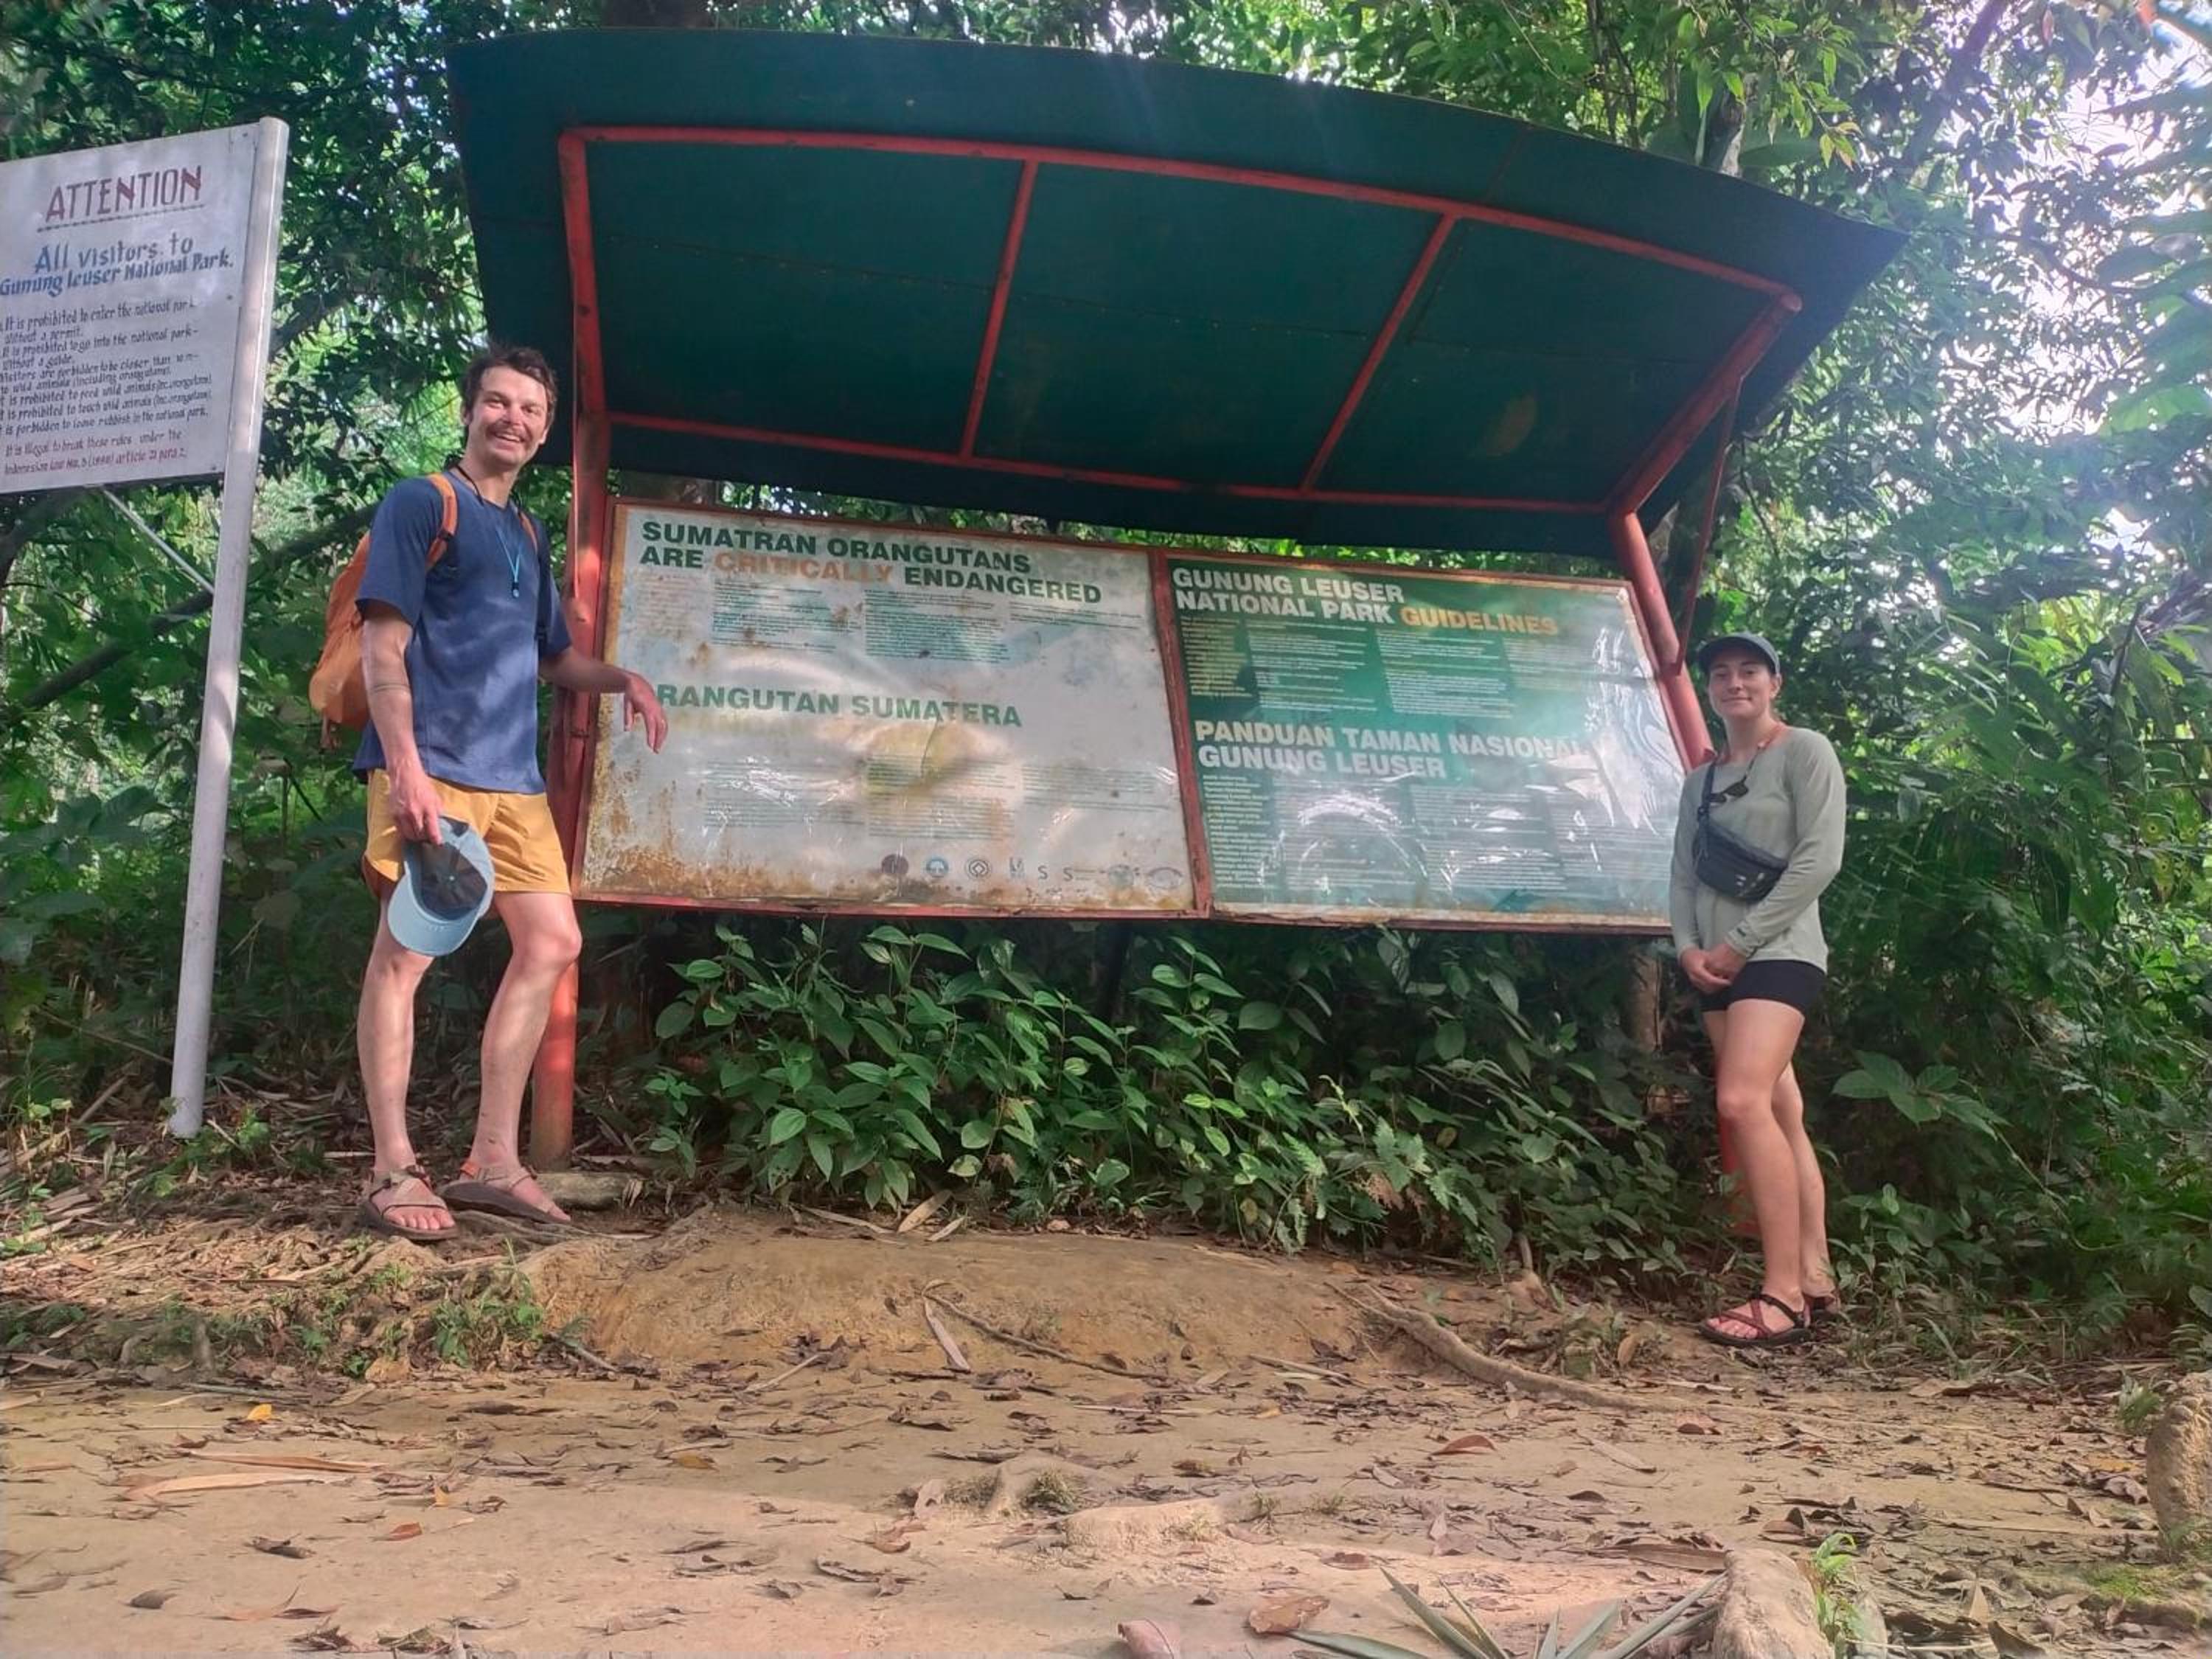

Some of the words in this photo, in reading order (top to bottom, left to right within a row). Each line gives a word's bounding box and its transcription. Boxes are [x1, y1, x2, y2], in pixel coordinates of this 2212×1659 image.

[46, 165, 202, 222] ATTENTION
[35, 243, 69, 274] All
[169, 232, 193, 255] to
[125, 257, 187, 280] National
[17, 316, 24, 330] is
[27, 310, 77, 331] prohibited
[91, 304, 116, 320] enter
[117, 301, 132, 318] the
[23, 341, 67, 358] prohibited
[131, 328, 168, 343] national
[18, 404, 63, 420] prohibited
[20, 390, 66, 406] prohibited
[15, 420, 60, 438] forbidden
[642, 521, 816, 554] SUMATRAN
[827, 538, 1031, 574] ORANGUTANS
[640, 546, 704, 569] ARE
[714, 553, 893, 583] CRITICALLY
[905, 566, 1102, 604] ENDANGERED
[1172, 568, 1293, 595] GUNUNG
[1301, 577, 1405, 603] LEUSER
[1176, 589, 1315, 618] NATIONAL
[1323, 599, 1394, 625] PARK
[1400, 605, 1558, 636] GUIDELINES
[655, 683, 839, 715] RANGUTAN
[852, 695, 1022, 728] SUMATERA
[1194, 720, 1333, 746] PANDUAN
[1342, 727, 1441, 754] TAMAN
[1197, 745, 1326, 773] GUNUNG
[1336, 752, 1446, 779] LEUSER
